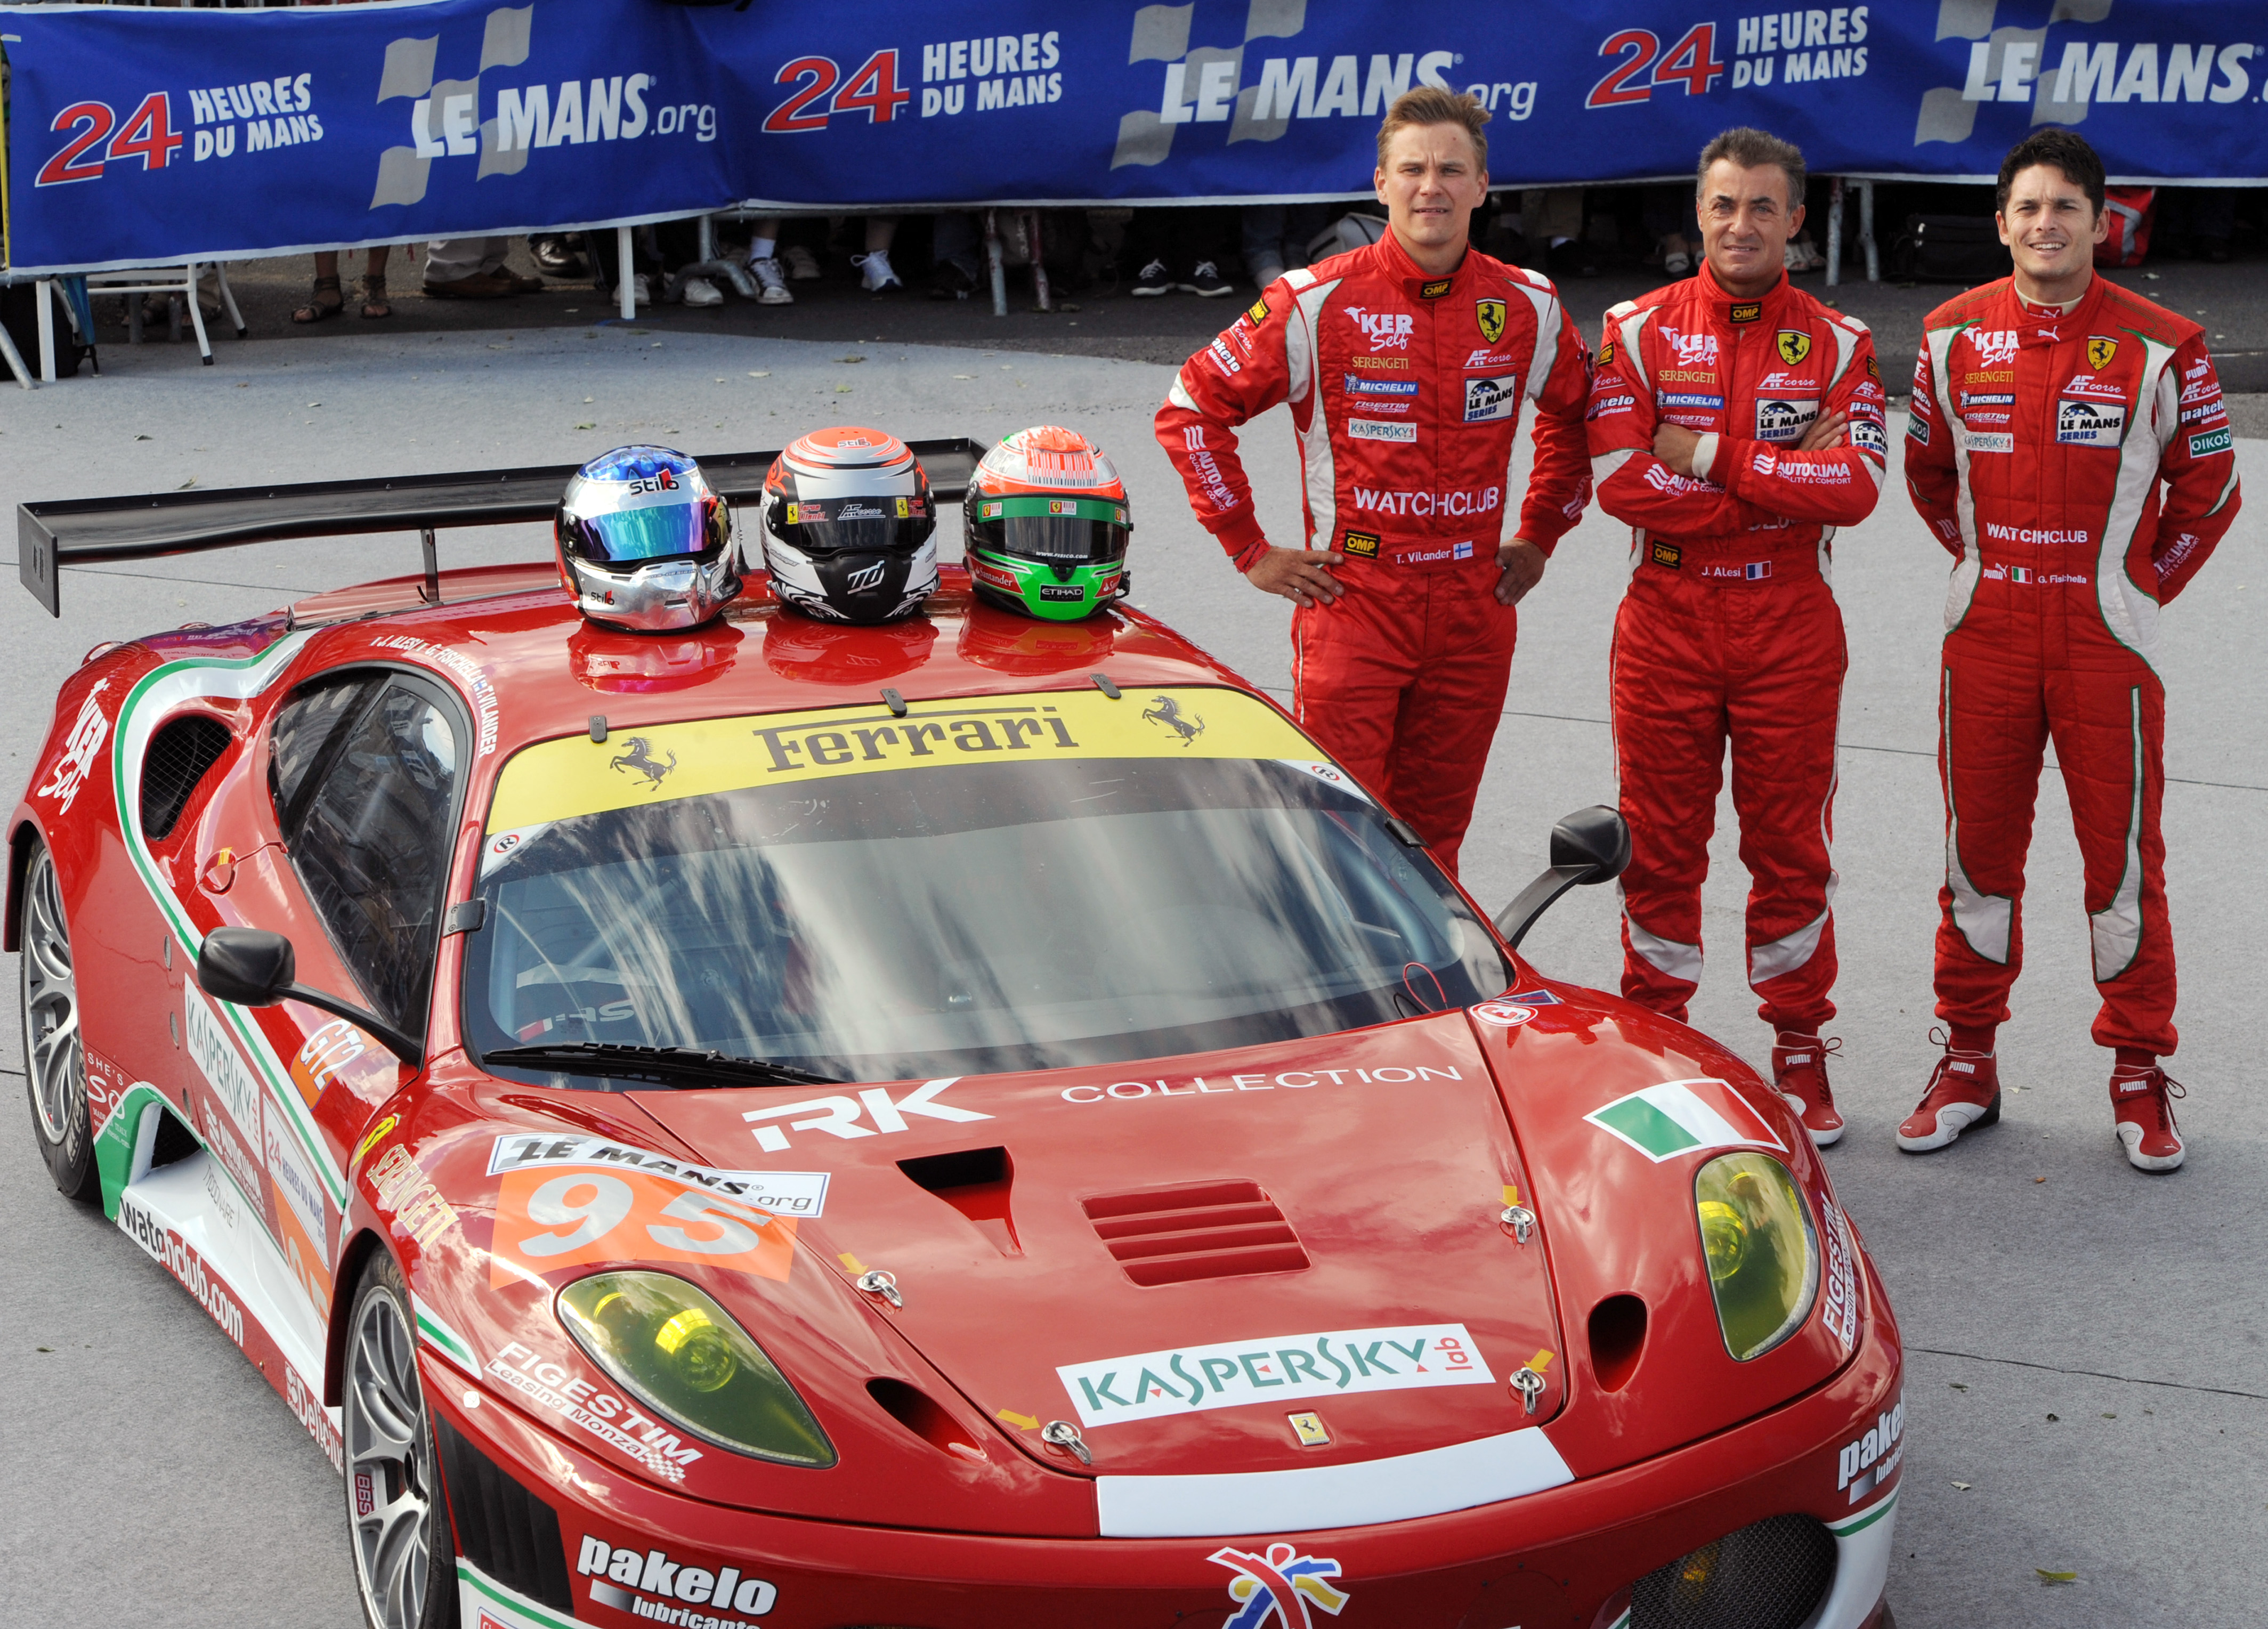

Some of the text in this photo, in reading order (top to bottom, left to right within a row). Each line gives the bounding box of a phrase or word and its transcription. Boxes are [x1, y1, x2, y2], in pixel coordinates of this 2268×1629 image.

[1736, 6, 1868, 57] HEURES
[922, 31, 1059, 83] HEURES
[1585, 21, 1723, 110] 24
[1732, 47, 1868, 90] DU MANS
[1962, 42, 2038, 103] LE
[188, 72, 313, 126] HEURES
[761, 48, 910, 134] 24
[921, 72, 1062, 118] DU MANS
[1160, 61, 1235, 124] LE
[411, 94, 476, 159] LE
[35, 91, 182, 188] 24
[193, 113, 324, 163] DU MANS
[1424, 283, 1448, 295] OMP
[1362, 314, 1414, 334] KER
[1733, 307, 1758, 319] OMP
[1370, 330, 1409, 352] Self
[1212, 337, 1241, 372] akelo
[1352, 356, 1409, 370] SERENGETI
[1488, 353, 1511, 363] corse
[1678, 345, 1716, 367] Self
[1980, 346, 2016, 368] Self
[1659, 370, 1715, 384] SERENGETI
[1964, 371, 2014, 384] SERENGETI
[2185, 364, 2208, 380] PUMA
[1359, 382, 1416, 393] MICHELIN
[1469, 386, 1512, 410] LE MANS
[2089, 383, 2122, 393] corse
[1355, 401, 1410, 409] FIGESTIM
[1586, 395, 1635, 419] pakelo
[1666, 395, 1722, 406] MICHELIN
[1970, 395, 2013, 403] MICHELIN
[1468, 405, 1497, 420] SERIES
[1664, 414, 1715, 423] FIGESTIM
[1760, 410, 1817, 429] LE MANS
[1351, 423, 1409, 438] KASPERSKY
[1760, 426, 1796, 439] SERIES
[2060, 418, 2120, 430] LE MANS
[1856, 433, 1868, 441] LE
[1964, 435, 2005, 447] KASPERSKY
[2060, 430, 2097, 441] SERIES
[2192, 432, 2230, 451] OIKOS
[1777, 462, 1851, 478] AUTOCLIMA
[1189, 453, 1208, 484] QUALITY
[1206, 490, 1227, 511] COMFO
[1354, 487, 1499, 516] WATCHCLUB
[1987, 522, 2087, 544] WATCHCLUB
[1347, 538, 1375, 552] OMP
[1655, 547, 1678, 563] OMP
[2153, 533, 2195, 574] TOCLIMA
[1396, 554, 1405, 564] T.
[979, 568, 1013, 587] Santander
[1702, 566, 1710, 576] J.
[1983, 569, 2003, 580] PUMA
[2050, 574, 2087, 584] Fisichella
[377, 635, 394, 647] J.
[385, 635, 425, 651] ALESI
[424, 644, 442, 656] G.
[433, 647, 487, 686] FISICHELLA
[478, 694, 499, 759] VILANDER
[753, 706, 1080, 773] Ferrari
[37, 749, 91, 816] Self
[187, 994, 252, 1130] KASPERSKY
[299, 1017, 367, 1091] GT2
[87, 1052, 124, 1086] SHE'S
[1949, 1062, 1975, 1074] PUMA
[1060, 1065, 1462, 1104] COLLECTION
[2120, 1081, 2147, 1092] PUMA
[742, 1076, 996, 1153] RK
[517, 1141, 572, 1161] LE
[268, 1129, 282, 1172] 24
[282, 1155, 301, 1196] HEURES
[301, 1180, 308, 1206] DU
[308, 1190, 323, 1228] MANS
[365, 1141, 461, 1252] SERENGETI
[518, 1172, 774, 1257] 95
[120, 1196, 244, 1348] watchclub.com
[1821, 1190, 1845, 1337] FIGESTIM
[1077, 1336, 1473, 1411] KASPERSKY lab
[489, 1359, 643, 1457] Leasing Monza
[497, 1341, 704, 1466] FIGESTIM
[1837, 1387, 1904, 1491] pakel
[357, 1475, 372, 1515] BBS
[577, 1534, 778, 1618] pakelo
